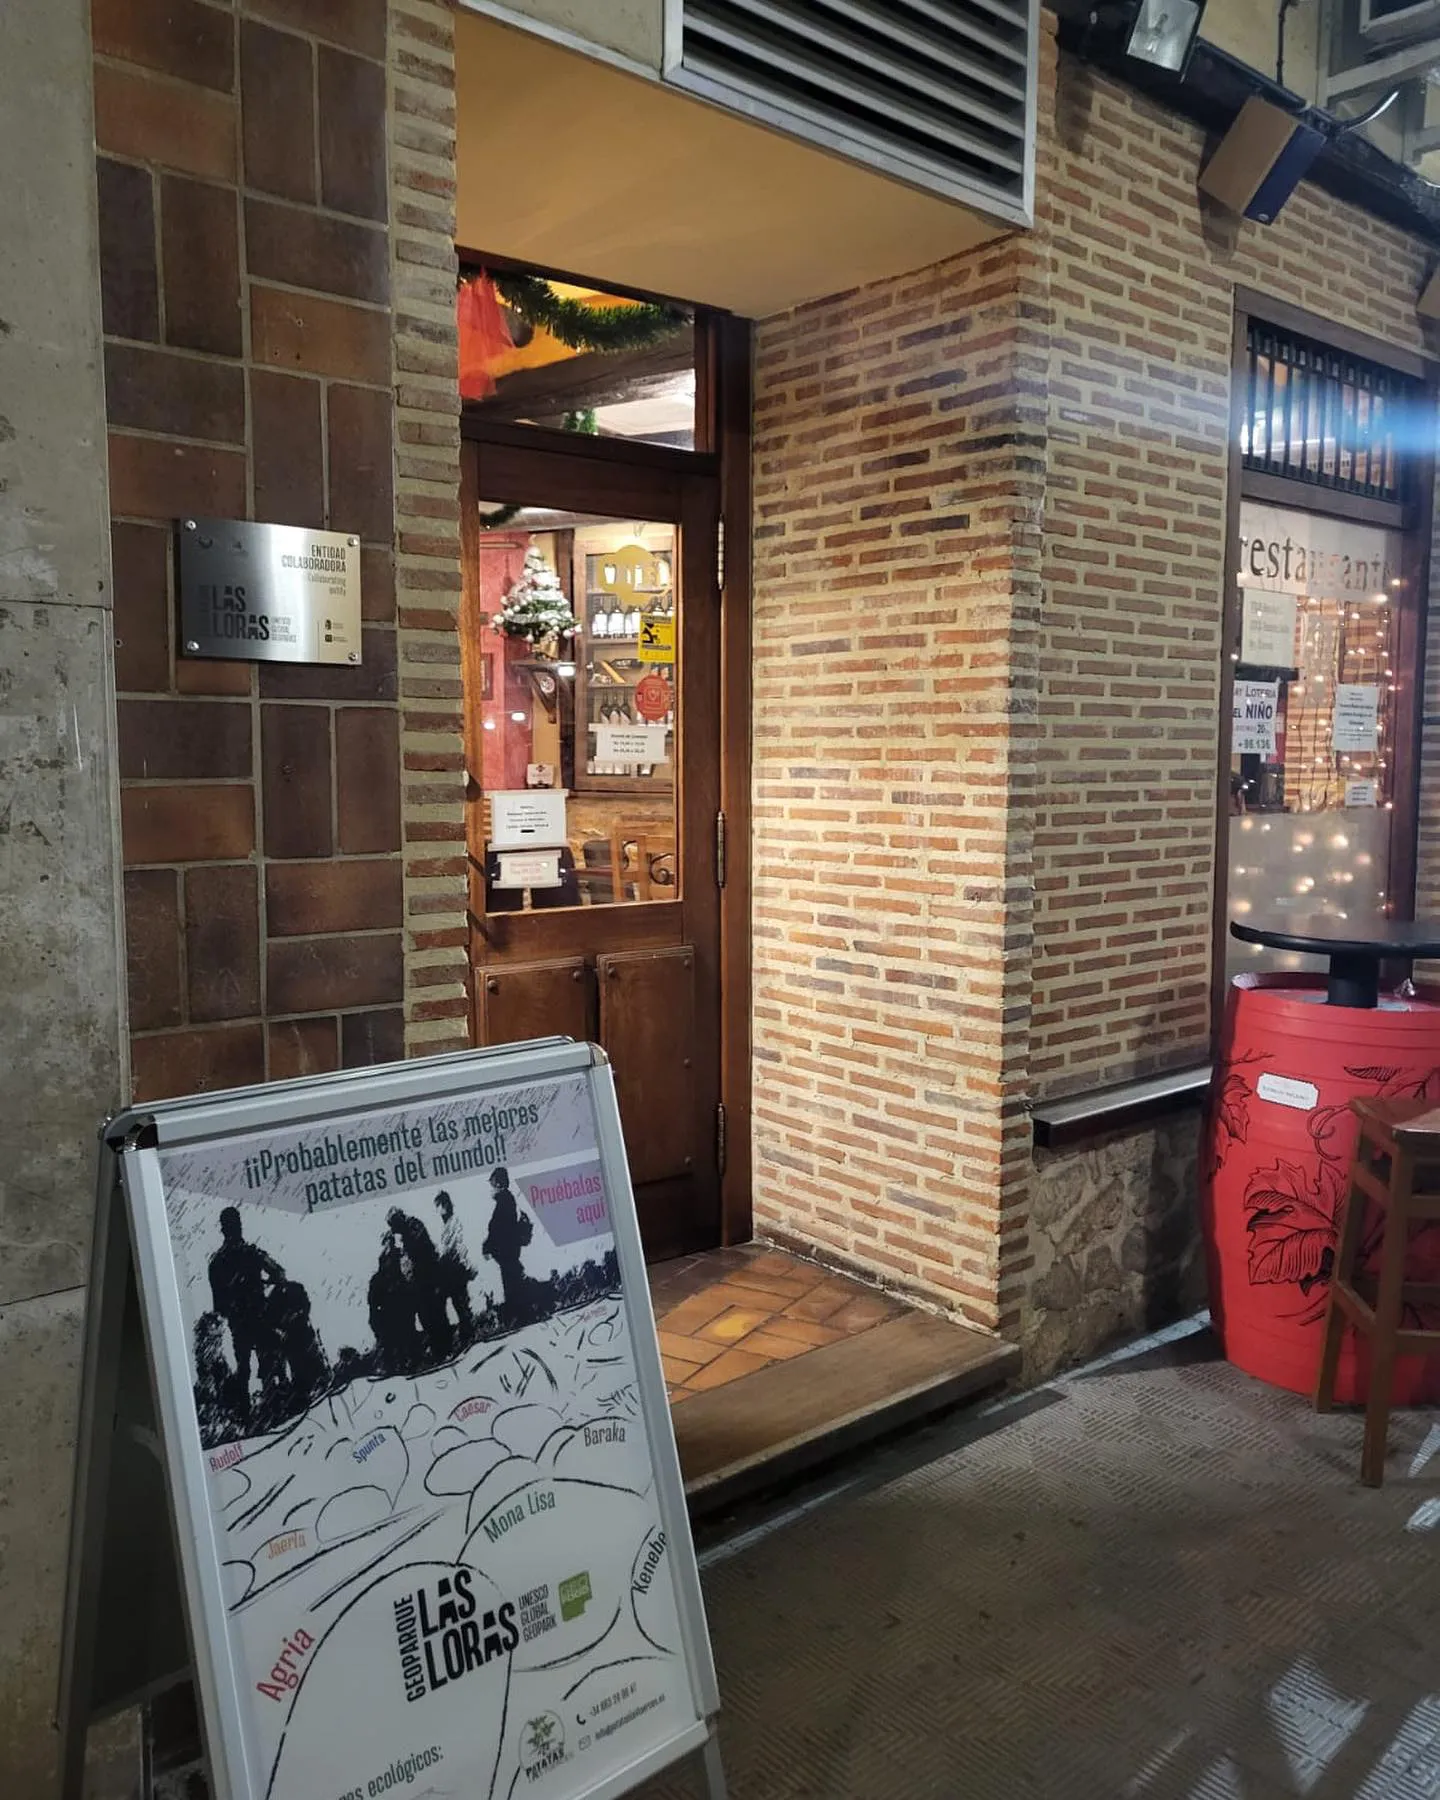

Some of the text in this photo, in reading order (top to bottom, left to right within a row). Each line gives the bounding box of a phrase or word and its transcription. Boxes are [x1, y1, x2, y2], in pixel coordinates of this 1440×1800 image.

[281, 555, 346, 573] COLABORADORA
[311, 544, 346, 560] ENTIDAD
[212, 584, 247, 613] LAS
[211, 612, 270, 641] LORAS
[1246, 700, 1273, 720] NIÑO
[428, 1116, 459, 1144] las
[464, 1103, 539, 1138] mejores
[305, 1134, 508, 1213] patatas del mundo!!
[454, 1399, 491, 1422] Caesar
[352, 1432, 387, 1464] Spunta
[583, 1421, 627, 1447] Baraka
[210, 1442, 243, 1472] Rudolf
[483, 1490, 556, 1544] Mona Lisa
[417, 1569, 476, 1638] LAS
[518, 1583, 549, 1611] UNESCO
[520, 1602, 548, 1626] GLOBAL
[522, 1613, 558, 1642] GEOPARK
[393, 1593, 427, 1702] GEOPARQUE
[423, 1601, 520, 1691] LORAS
[256, 1628, 316, 1702] Agria
[367, 1745, 444, 1798] ecológicos:
